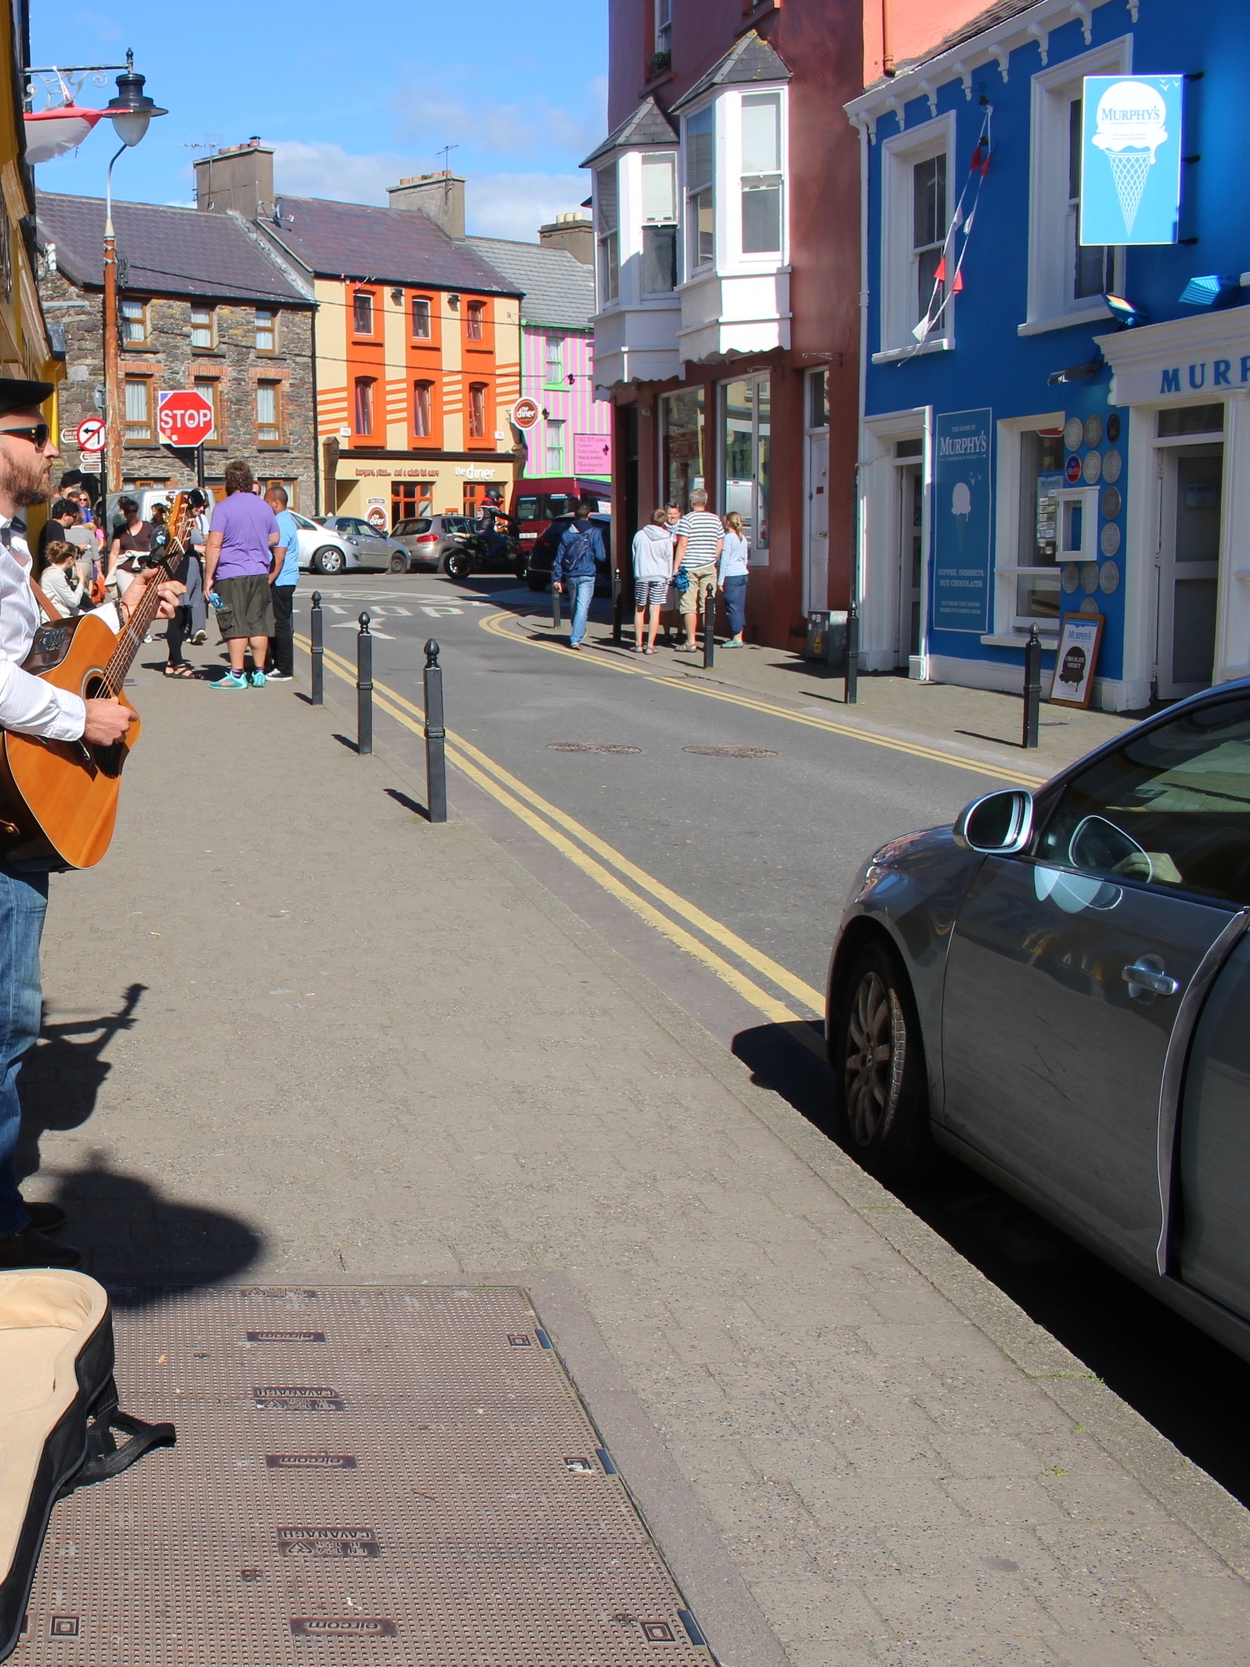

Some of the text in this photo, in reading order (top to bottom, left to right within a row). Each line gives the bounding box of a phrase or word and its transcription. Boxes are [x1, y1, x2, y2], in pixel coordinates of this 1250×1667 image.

[1101, 106, 1160, 121] MURPHY'S
[517, 408, 535, 418] diner
[161, 409, 211, 428] STOP
[940, 430, 987, 455] MURPHY'S
[455, 462, 495, 480] the diner
[257, 1389, 334, 1397] CAVANAGH
[280, 1457, 342, 1465] eircom
[283, 1530, 370, 1539] CAVANAGH
[307, 1621, 379, 1630] eircom
